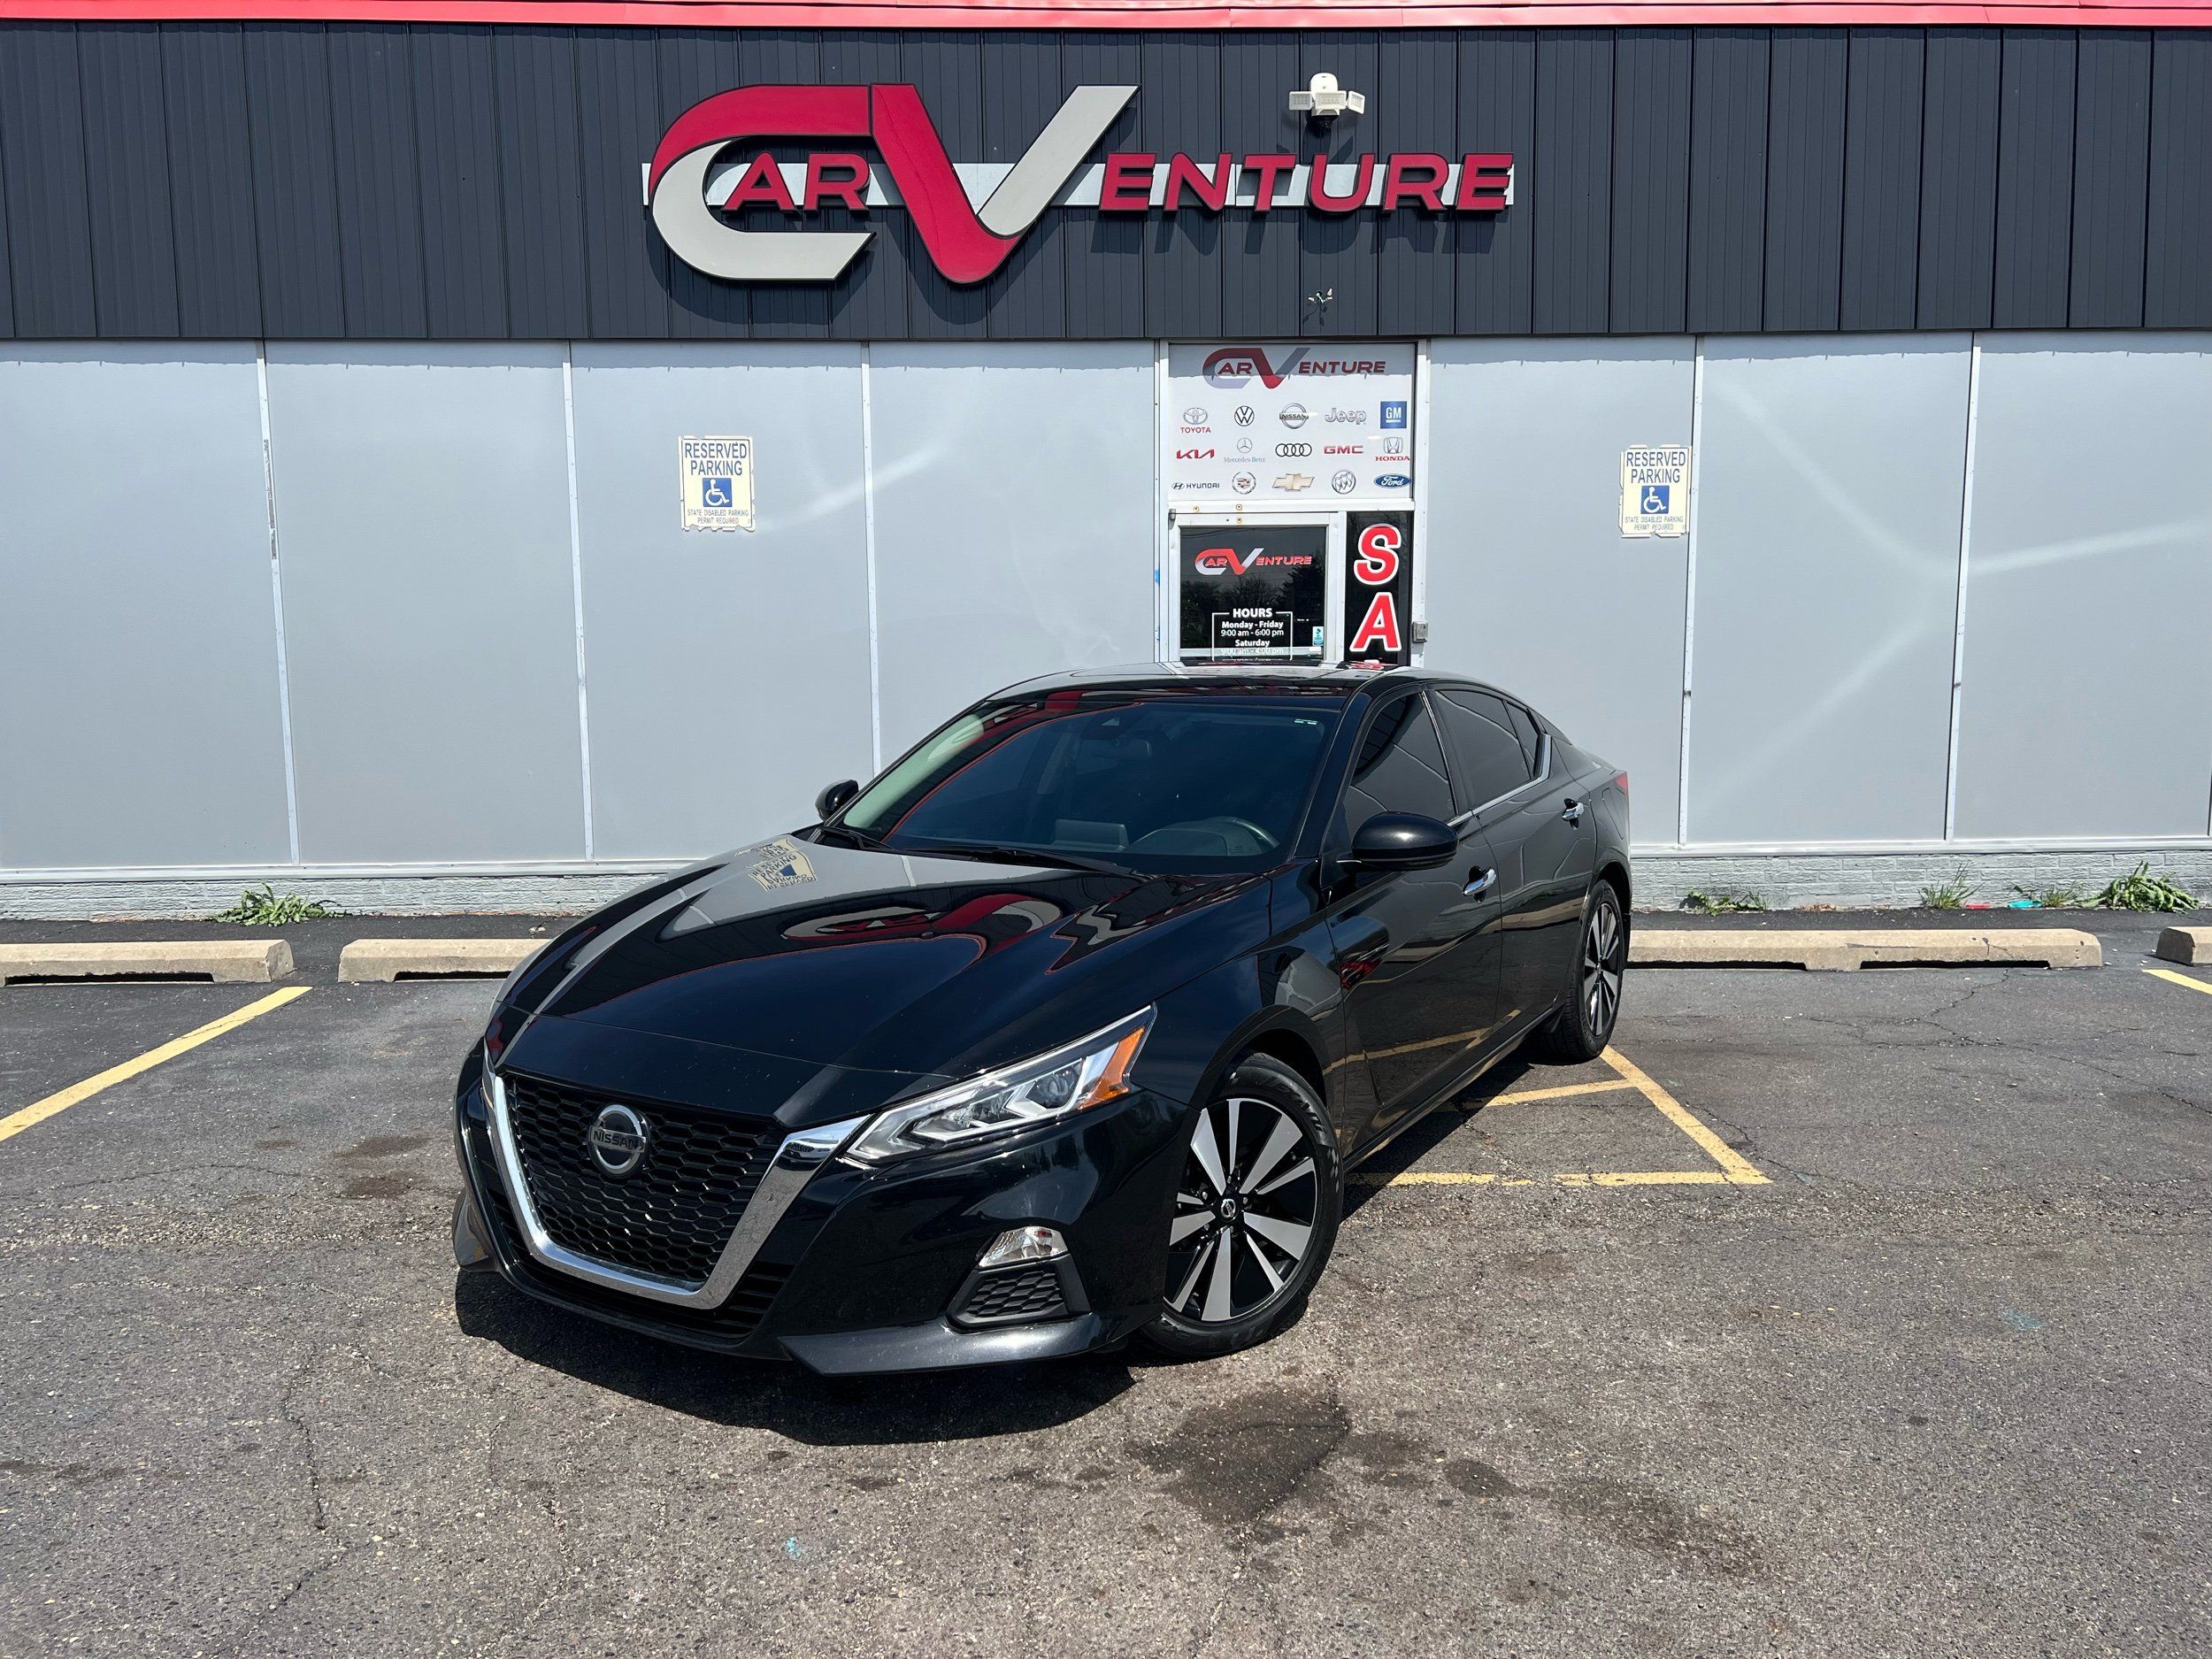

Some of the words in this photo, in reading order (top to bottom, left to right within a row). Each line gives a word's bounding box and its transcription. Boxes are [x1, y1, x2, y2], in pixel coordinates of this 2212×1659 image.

[1325, 407, 1367, 425] Jeep
[1386, 407, 1402, 419] GM
[685, 442, 748, 458] RESERVED
[1176, 449, 1215, 459] KIA
[1323, 445, 1364, 454] GMC
[1626, 451, 1686, 467] RESERVED
[690, 460, 743, 476] PARKING
[1380, 473, 1404, 486] Ford
[1631, 468, 1680, 484] PARKING
[1233, 607, 1273, 618] HOURS
[1221, 620, 1254, 630] Monday
[1259, 619, 1284, 629] Friday
[1234, 638, 1271, 648] Saturday
[593, 1130, 638, 1149] NISSAN
